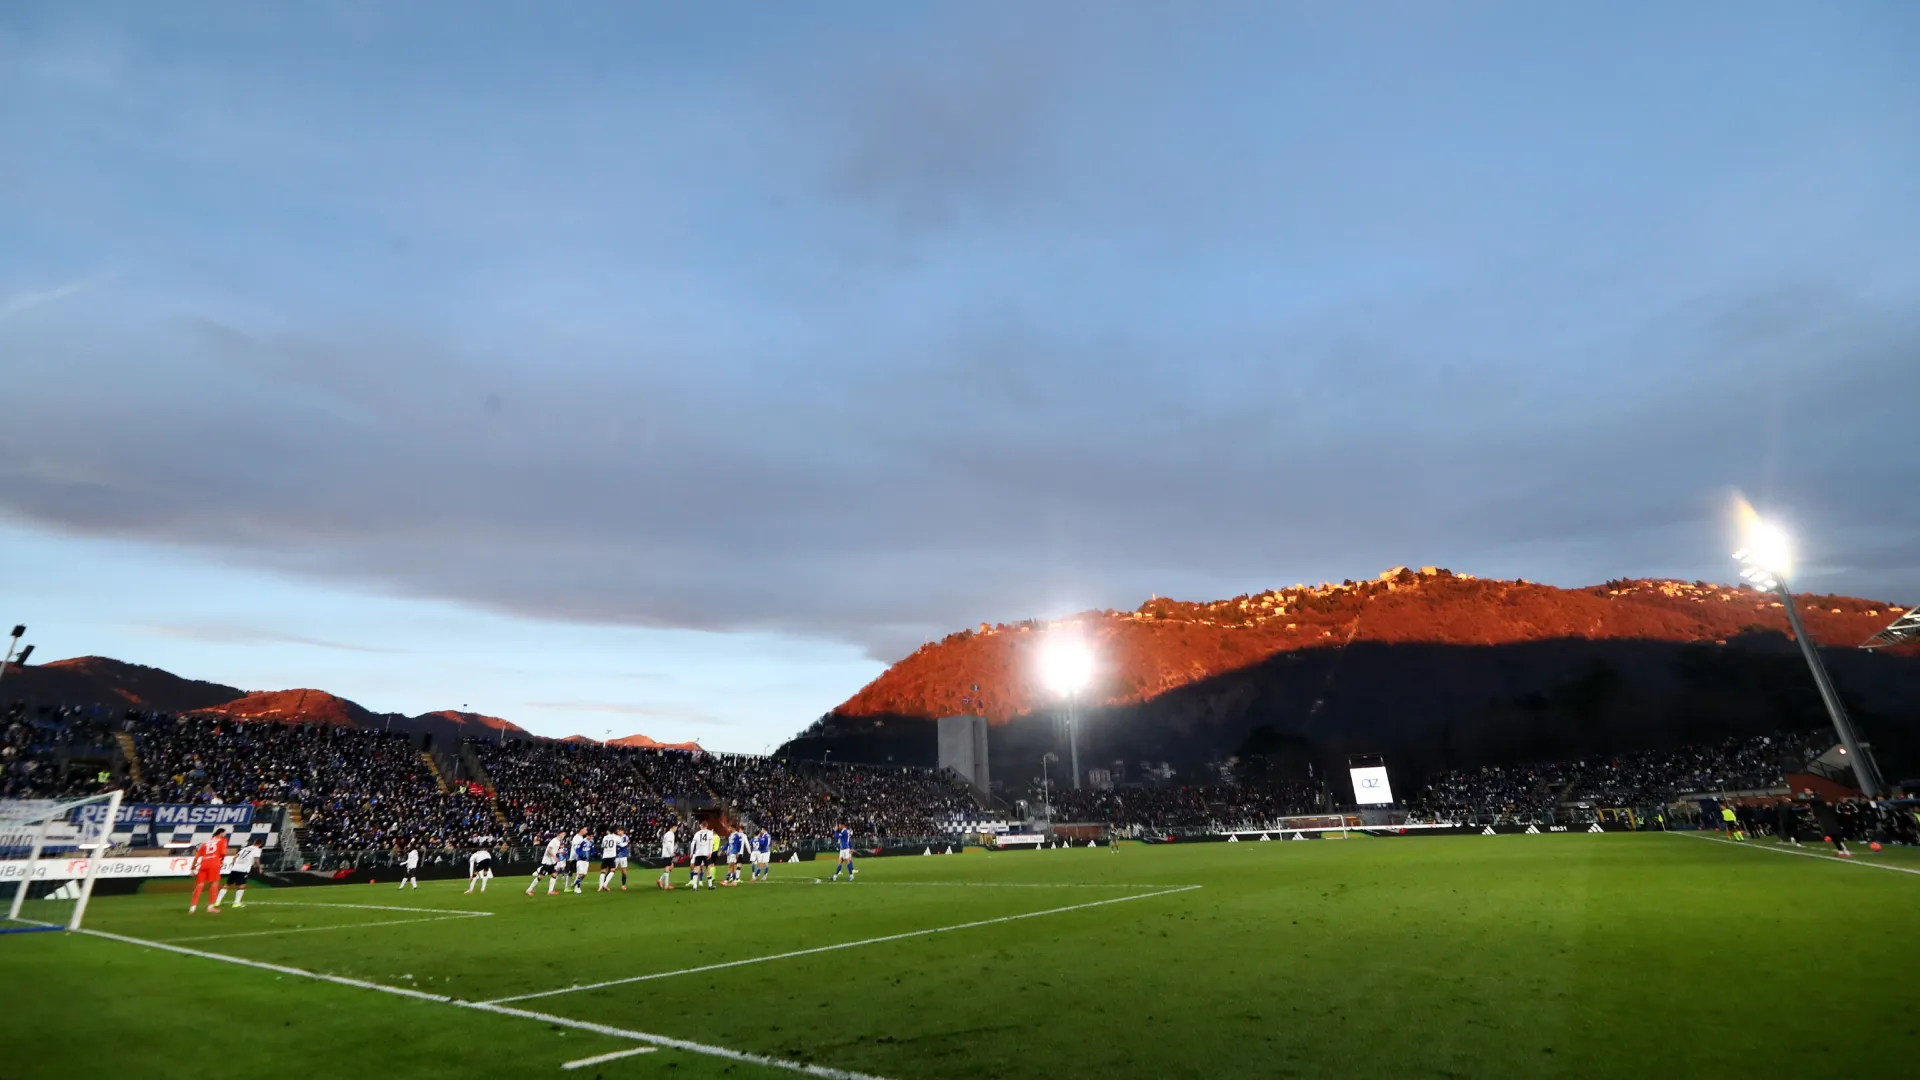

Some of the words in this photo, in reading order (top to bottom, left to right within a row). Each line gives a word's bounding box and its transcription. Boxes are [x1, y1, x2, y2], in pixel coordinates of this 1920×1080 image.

[155, 806, 247, 823] MASSIMI
[699, 833, 708, 842] 14
[604, 839, 615, 849] 20
[241, 849, 252, 860] 17
